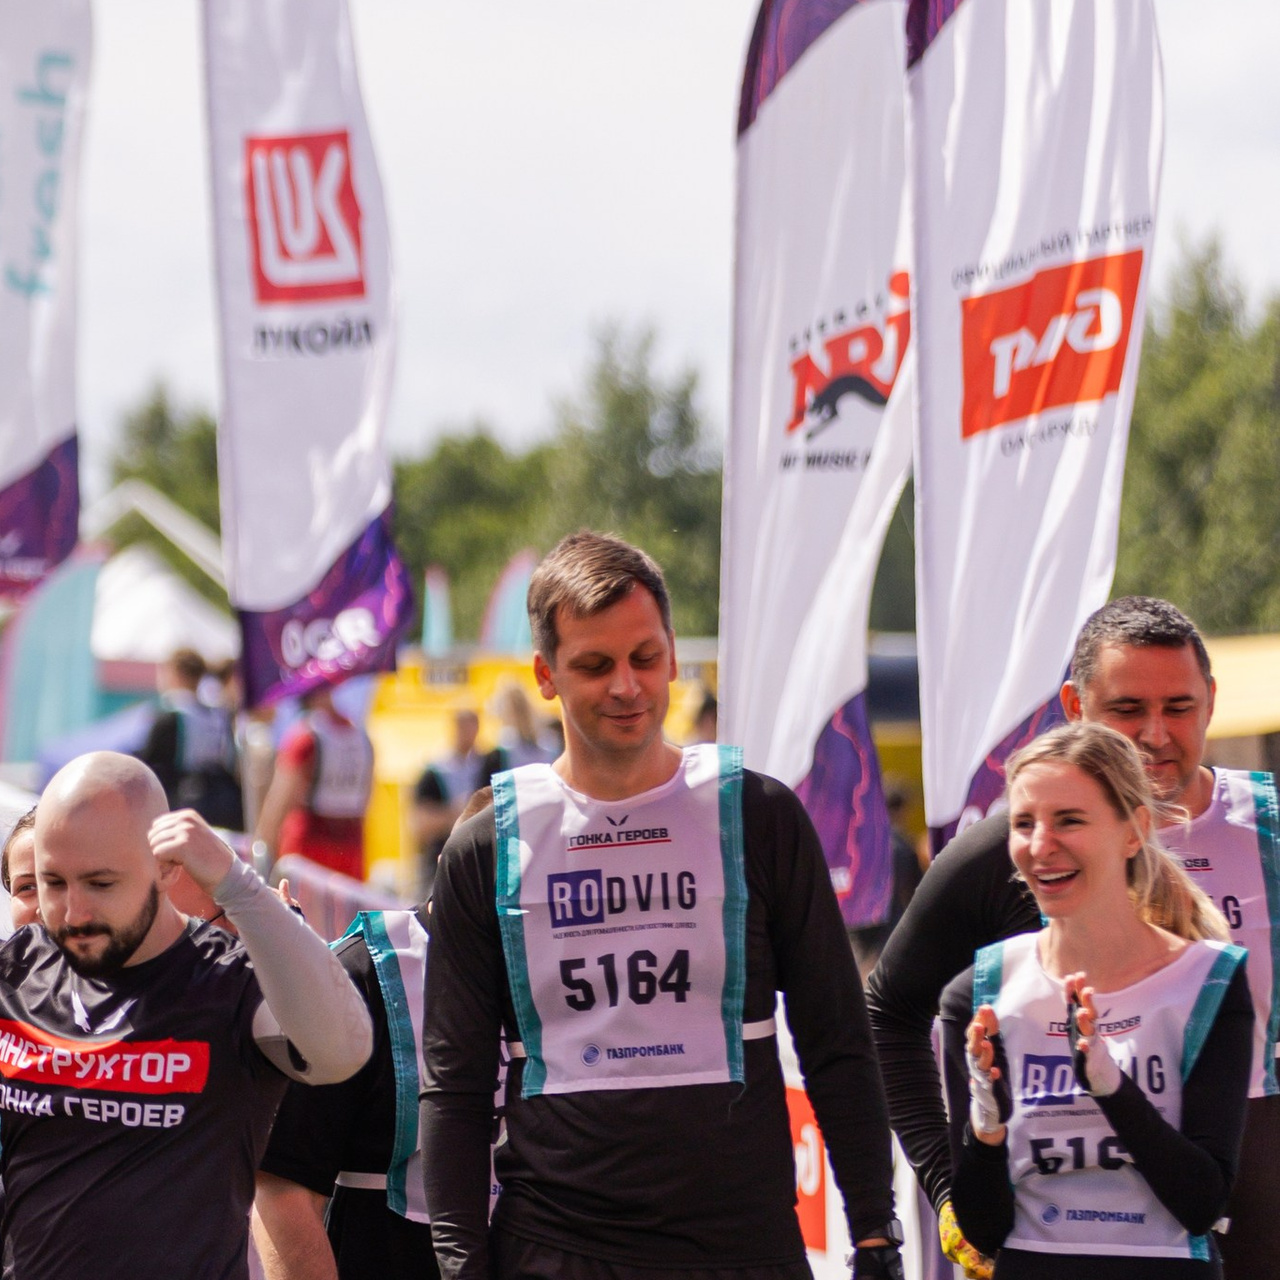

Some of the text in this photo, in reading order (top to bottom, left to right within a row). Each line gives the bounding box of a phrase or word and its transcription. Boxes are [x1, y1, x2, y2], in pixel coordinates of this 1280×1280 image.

[570, 827, 669, 847] ГОНКА ГЕРОЕВ
[552, 870, 697, 921] RODVIG
[559, 949, 692, 1012] 5164
[1098, 1015, 1142, 1033] ГЕРОЕВ
[606, 1043, 686, 1060] ГАЗПРОМБАНК
[63, 1095, 186, 1129] ГЕРОЕВ
[1066, 1208, 1146, 1225] ГАЗПРОМБАНК
